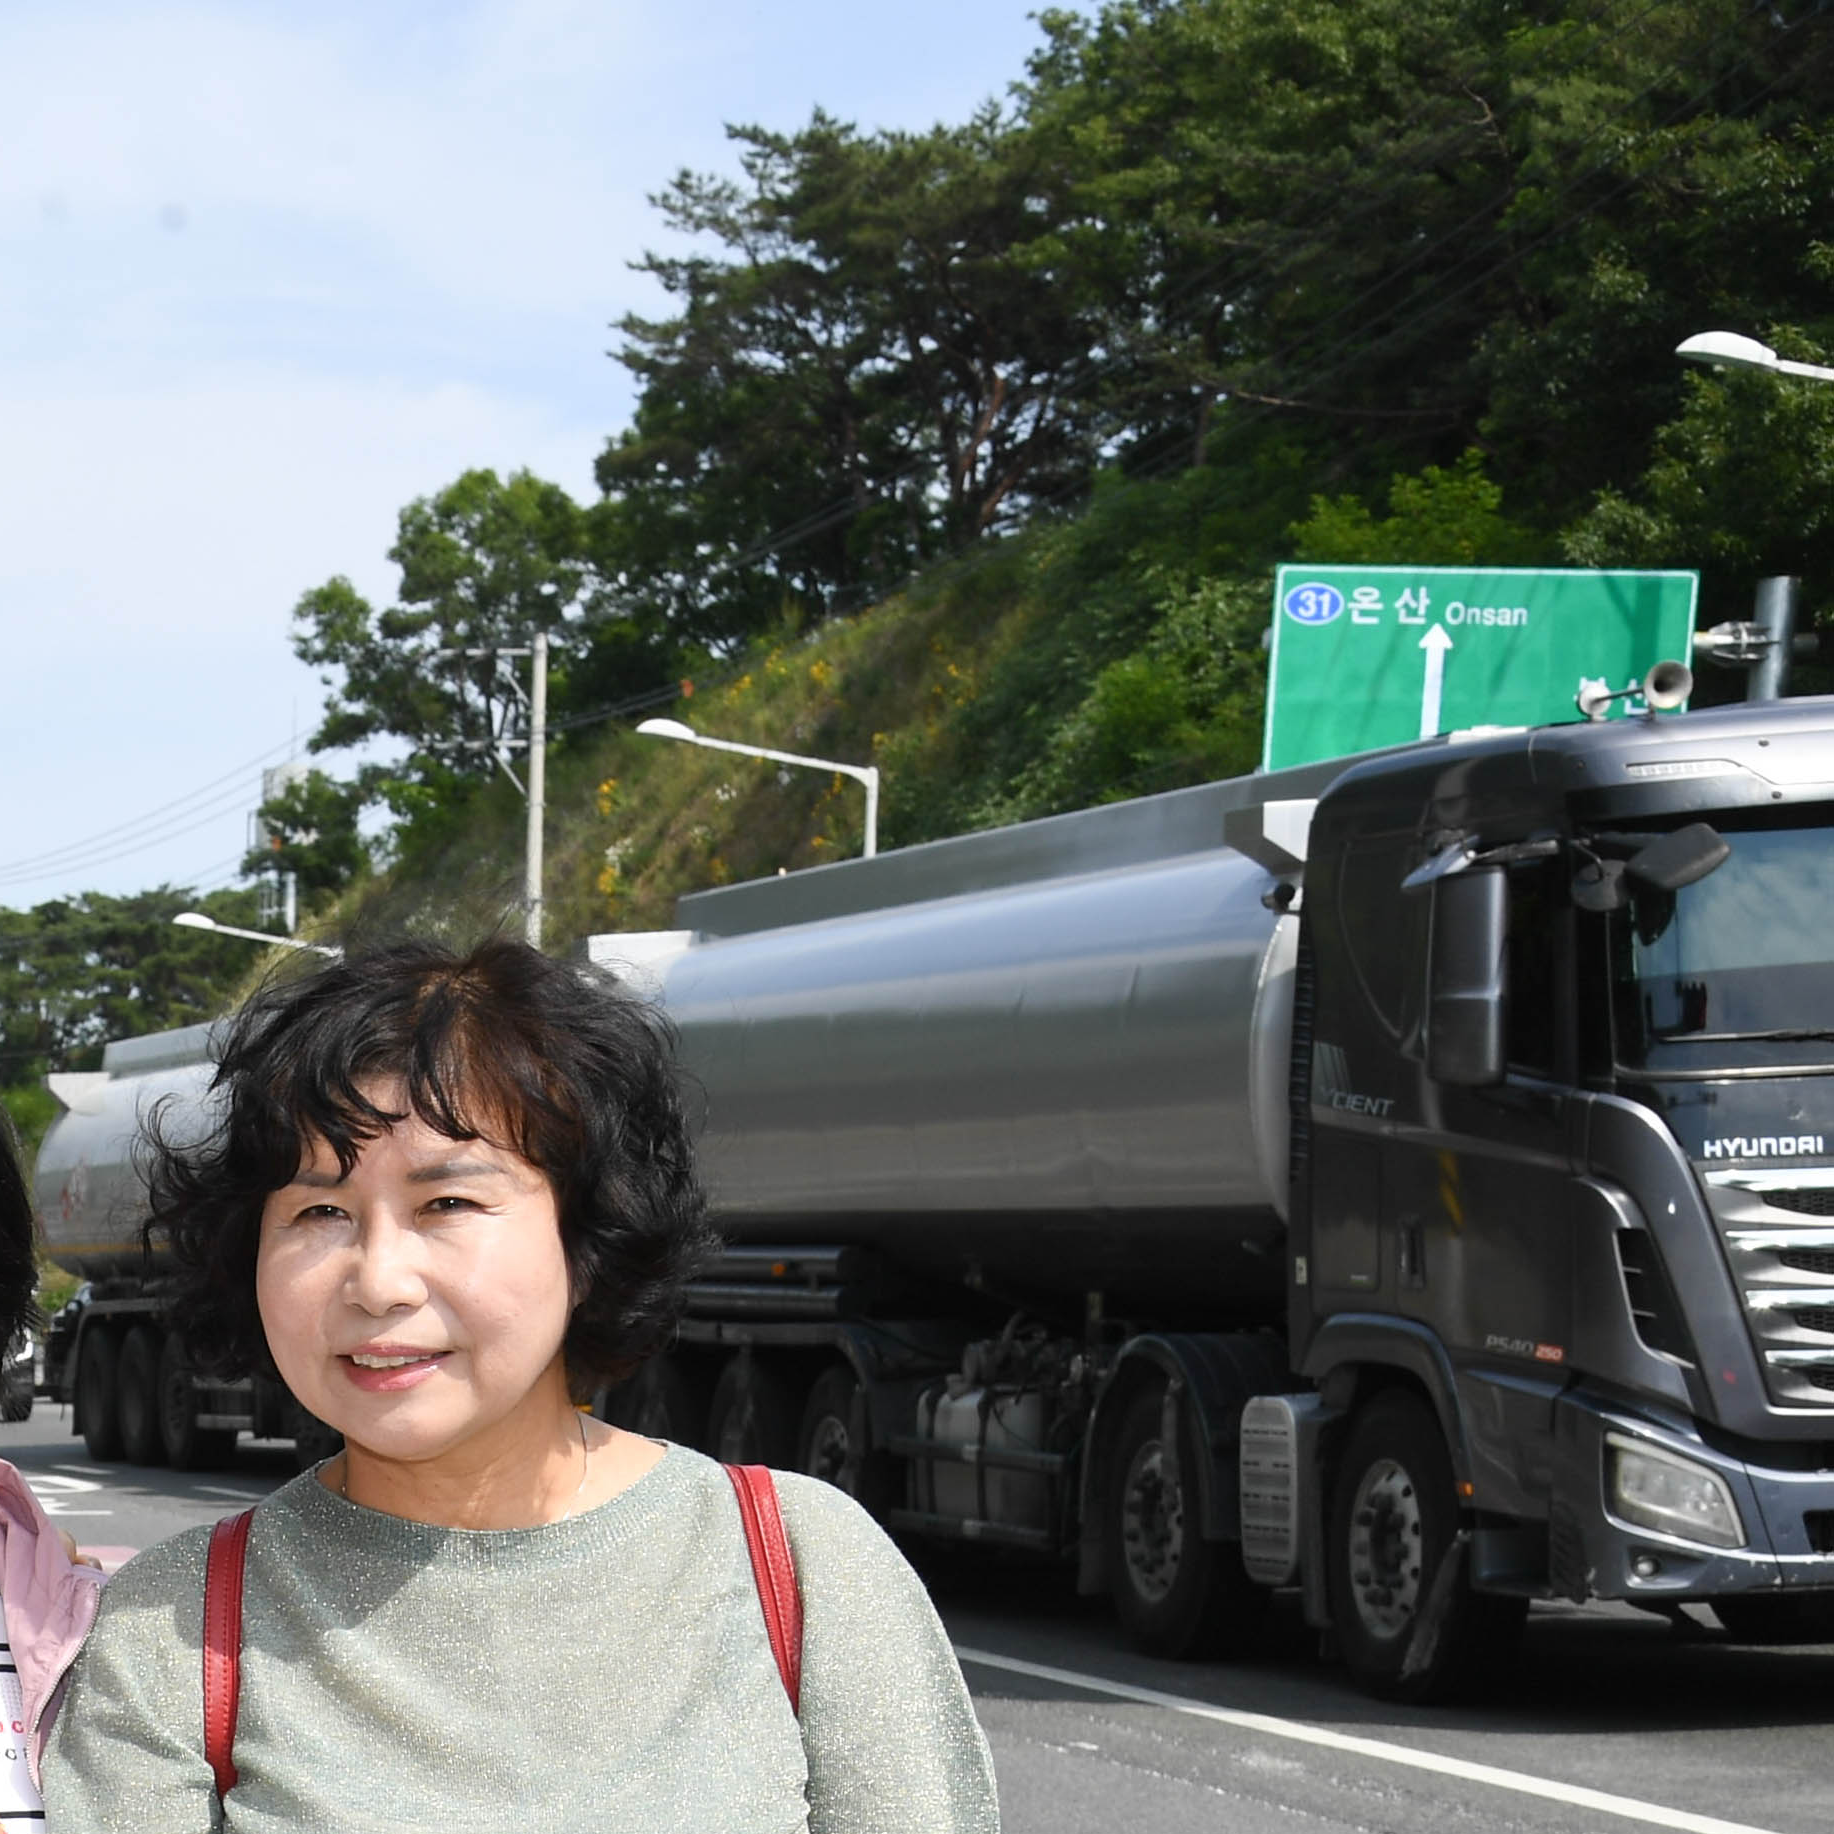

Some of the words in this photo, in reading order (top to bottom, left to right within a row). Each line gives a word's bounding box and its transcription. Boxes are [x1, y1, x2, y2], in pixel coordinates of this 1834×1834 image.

[1298, 590, 1331, 618] 31
[1445, 601, 1529, 627] Onsan
[1703, 1135, 1825, 1158] HYUNDAI
